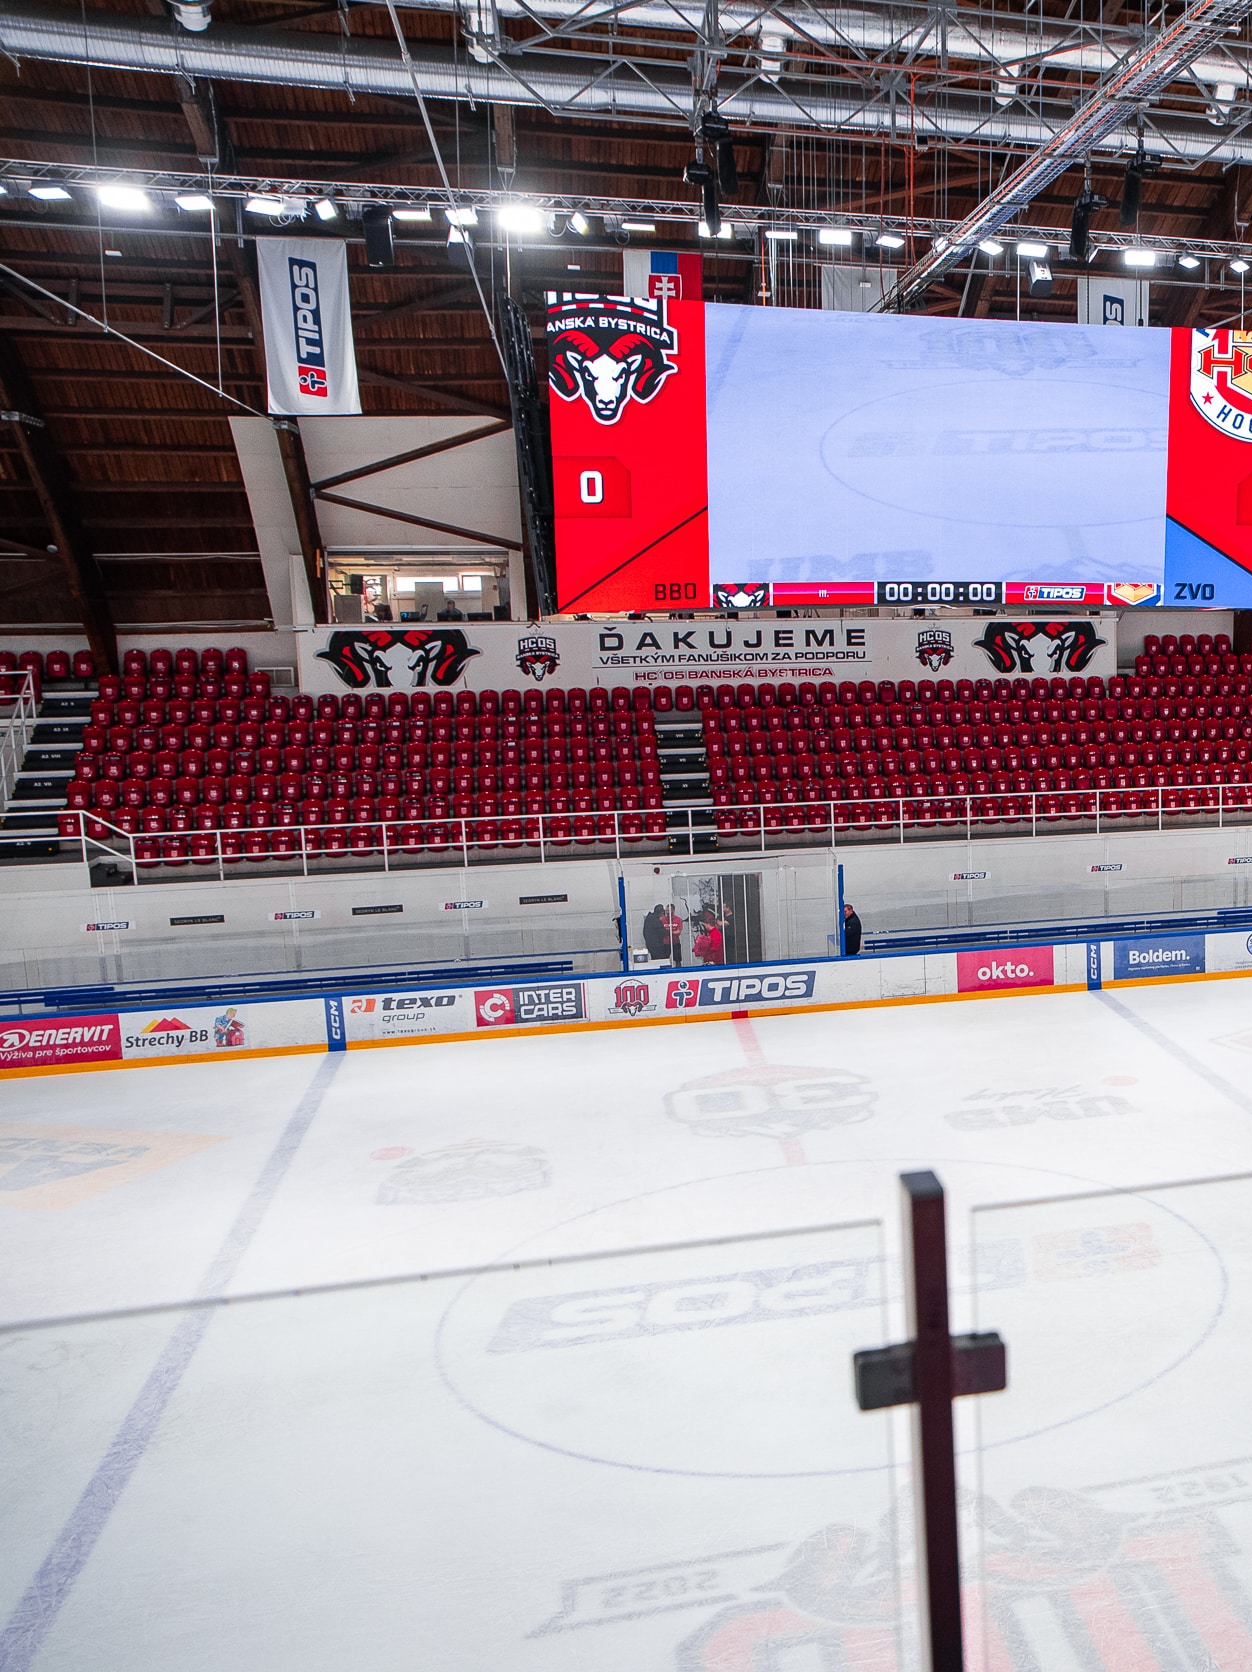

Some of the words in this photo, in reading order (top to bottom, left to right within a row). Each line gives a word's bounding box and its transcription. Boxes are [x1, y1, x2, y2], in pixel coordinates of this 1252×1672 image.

[292, 264, 321, 359] TIPOS
[599, 316, 670, 344] BYSTRICA
[580, 470, 604, 505] 0
[885, 583, 996, 601] 00:00:00
[1041, 587, 1082, 599] TIPOS
[598, 626, 866, 652] ĎAKUJEME
[599, 652, 675, 665] VŠETKÝM
[678, 650, 768, 663] FANÚŠIKOM
[771, 652, 792, 661] ZA
[795, 651, 866, 661] PODPORU
[688, 666, 754, 679] BANSKÁ
[758, 667, 833, 678] BYSTRICA
[97, 922, 128, 930] TIPOS
[1090, 944, 1098, 980] CCM
[1129, 949, 1190, 965] Boldem.
[977, 961, 1035, 981] okto.
[519, 987, 577, 1005] INTER
[614, 984, 649, 1008] 100
[708, 975, 809, 1001] TIPOS
[381, 995, 456, 1011] texo
[520, 1003, 577, 1019] CARS
[330, 1000, 341, 1040] CCM
[382, 1012, 425, 1023] group
[29, 1025, 114, 1047] ENERVIT
[125, 1033, 185, 1049] Strechy
[189, 1029, 209, 1043] BB
[36, 1049, 53, 1058] pre
[55, 1044, 112, 1056] športovcov
